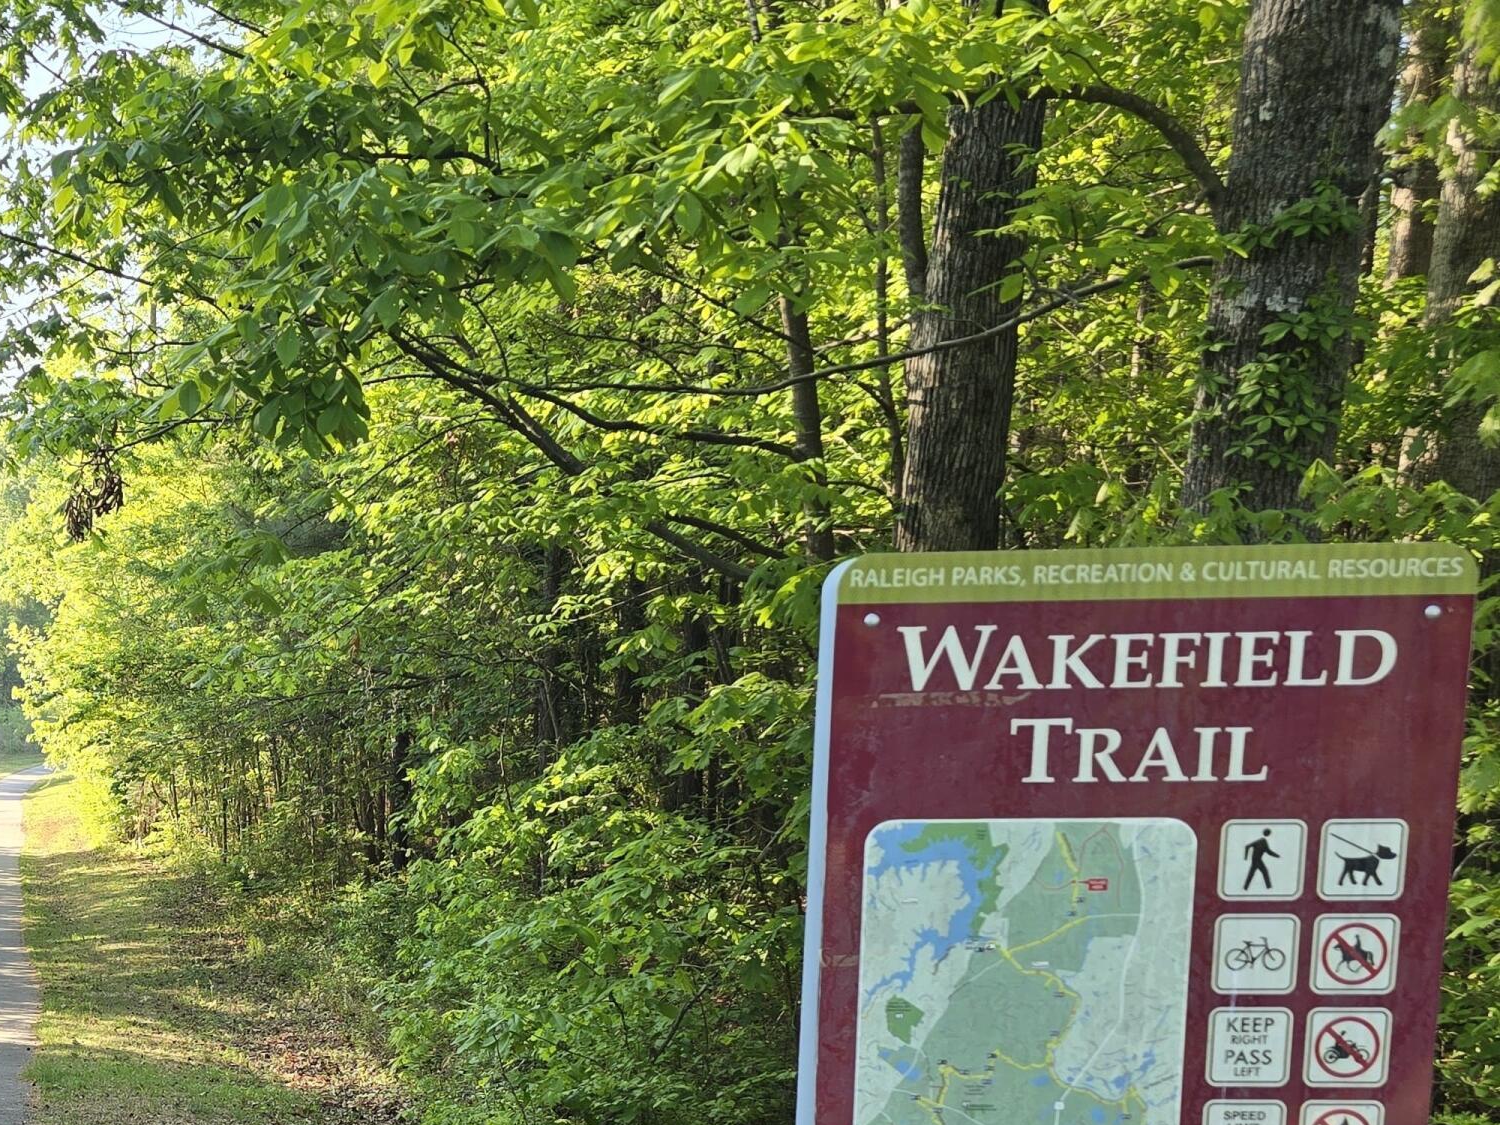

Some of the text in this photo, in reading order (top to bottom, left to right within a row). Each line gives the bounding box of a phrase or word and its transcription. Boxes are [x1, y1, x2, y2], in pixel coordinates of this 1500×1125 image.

[850, 556, 1464, 588] RALEIGH PARKS, RECREATION & CULTURAL RESOURCES
[897, 624, 1399, 692] WAKEFIELD
[1010, 717, 1268, 783] TRAIL
[1226, 1017, 1275, 1033] KEEP
[1230, 1035, 1268, 1045] RIGHT
[1224, 1049, 1272, 1065] PASS
[1233, 1067, 1261, 1077] LEFT
[1223, 1111, 1266, 1121] SPEED
